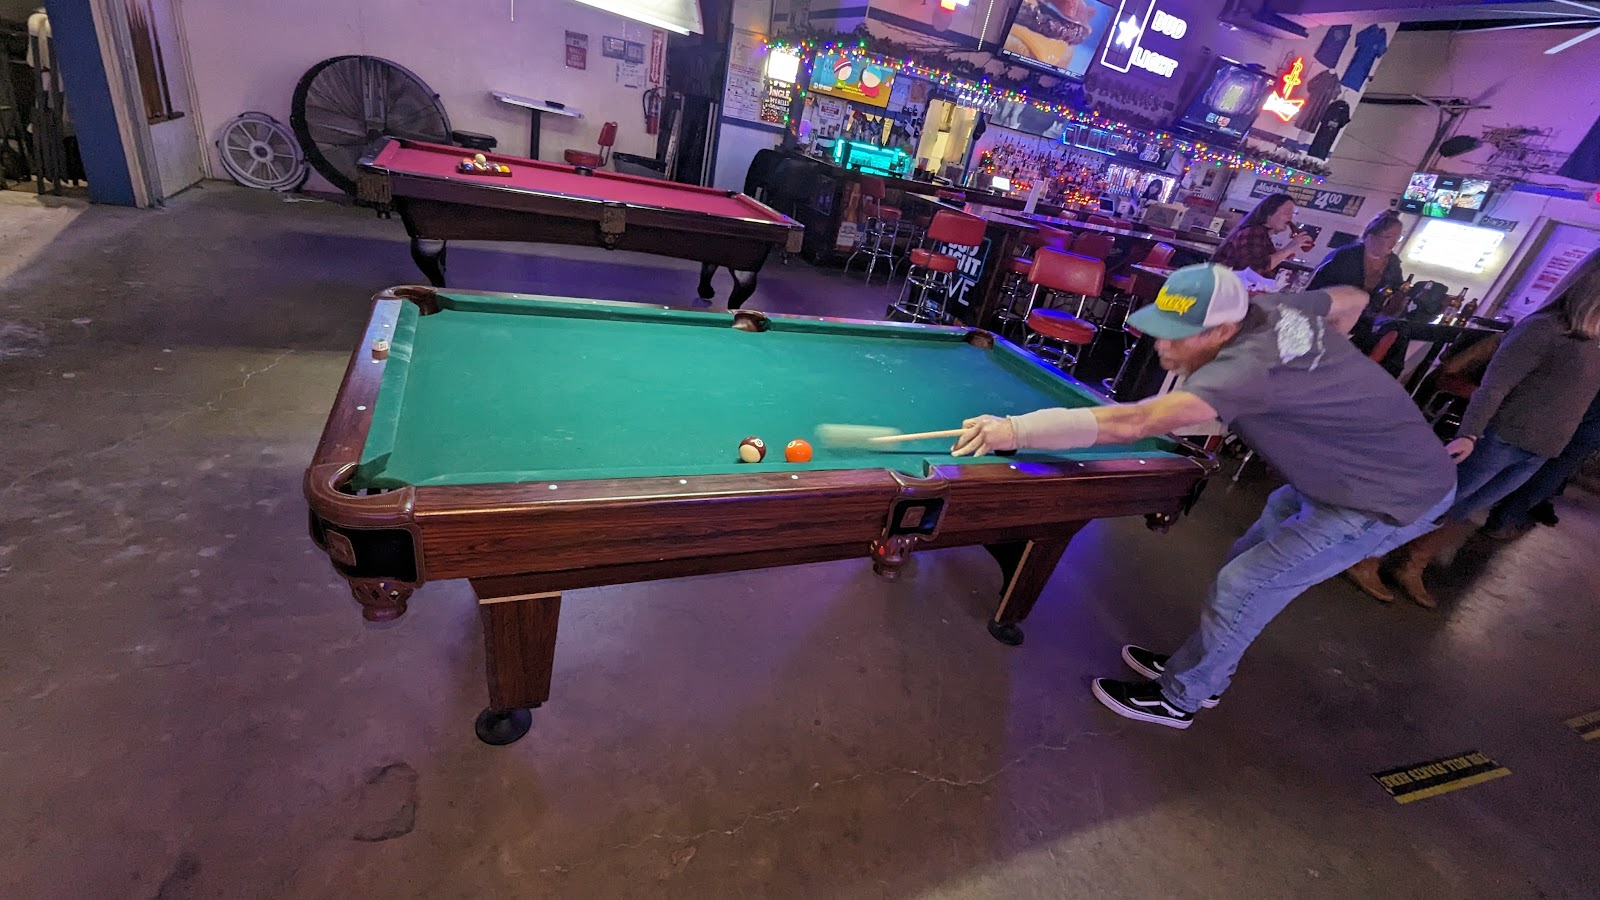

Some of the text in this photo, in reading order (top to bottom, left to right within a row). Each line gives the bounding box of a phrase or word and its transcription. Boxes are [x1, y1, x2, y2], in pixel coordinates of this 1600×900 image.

[1151, 10, 1187, 39] BUD
[1131, 46, 1178, 78] LIGHT
[769, 85, 790, 98] JINGLE
[1408, 762, 1449, 780] STARTS
